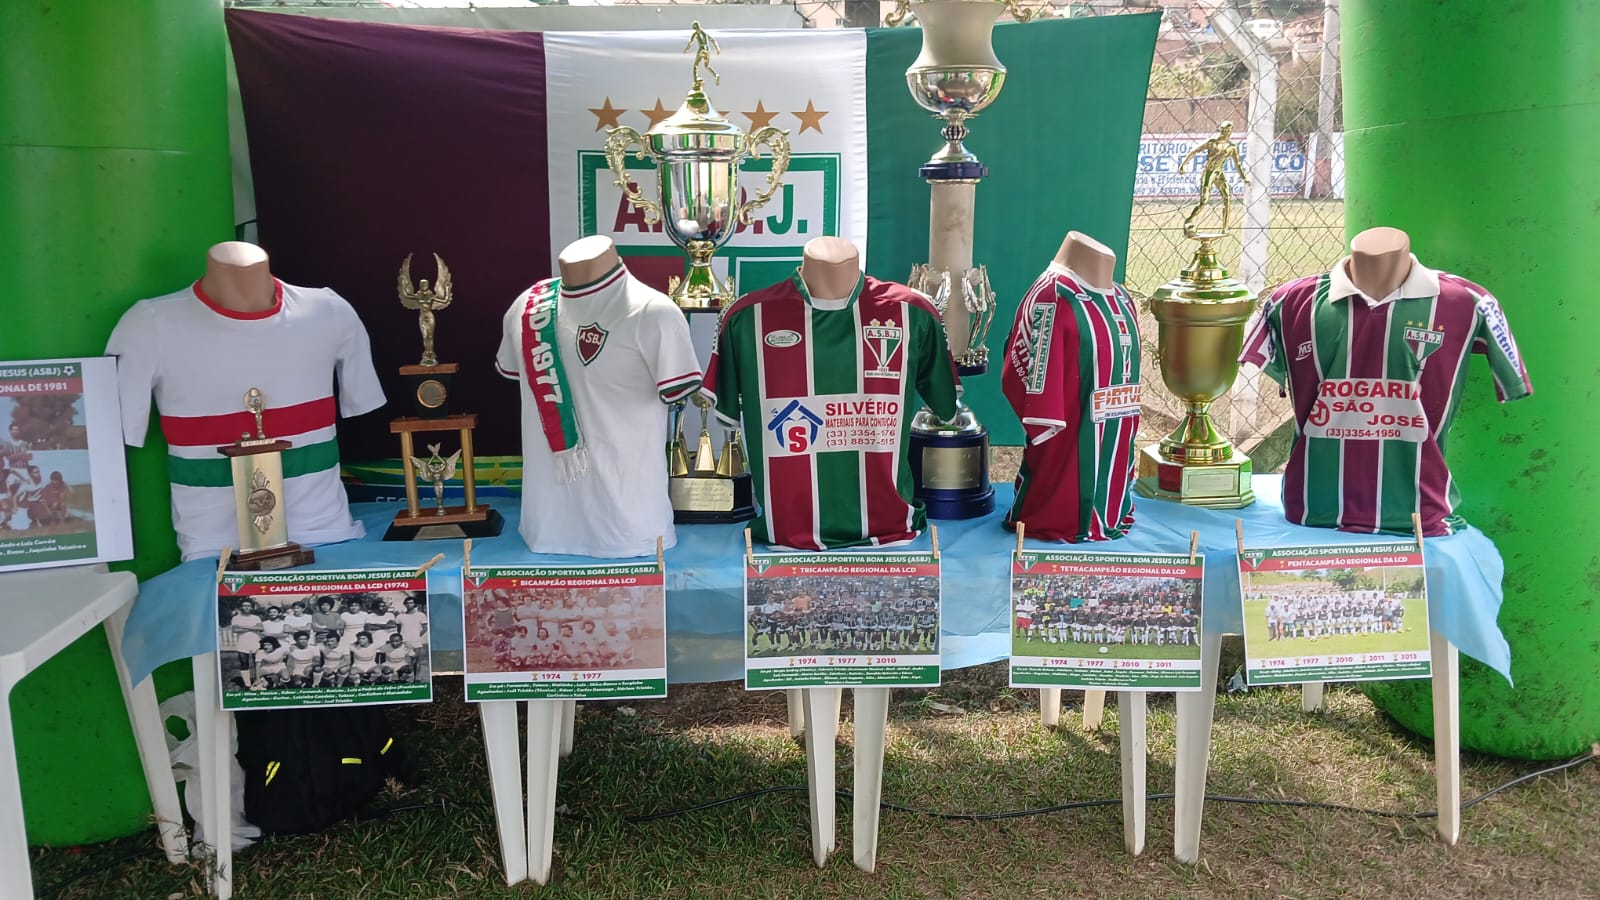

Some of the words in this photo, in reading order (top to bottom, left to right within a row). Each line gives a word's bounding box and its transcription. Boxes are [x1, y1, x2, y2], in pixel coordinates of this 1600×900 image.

[867, 329, 900, 339] A.S.B.J.
[1406, 332, 1441, 344] A.S.B.J.
[1035, 306, 1054, 390] ENGENHARIA
[0, 368, 27, 377] ESUS
[29, 366, 61, 377] (ASBJ)
[28, 383, 42, 391] DE
[45, 382, 67, 391] 1981
[1332, 400, 1375, 413] SÃO
[1367, 414, 1425, 428] JOSÉ
[826, 430, 848, 440] (33)
[1326, 428, 1401, 438] (33)3354-1950
[788, 426, 808, 453] S
[826, 439, 848, 448] (33)
[1271, 548, 1318, 557] ASSOCIAÇÃO
[1319, 547, 1355, 555] SPORTIVA
[779, 556, 827, 564] ASSOCIAÇÃO
[1287, 558, 1346, 567] PENTACAMPEÃO
[1346, 557, 1382, 565] REGIONAL
[547, 568, 586, 576] SPORTIVA
[1060, 565, 1122, 573] TETRACAMPEÃO
[252, 574, 304, 583] ASSOCIAÇÃO
[306, 573, 346, 581] SPORTIVA
[269, 584, 310, 592] CAMPEÃO
[311, 583, 353, 592] REGIONAL
